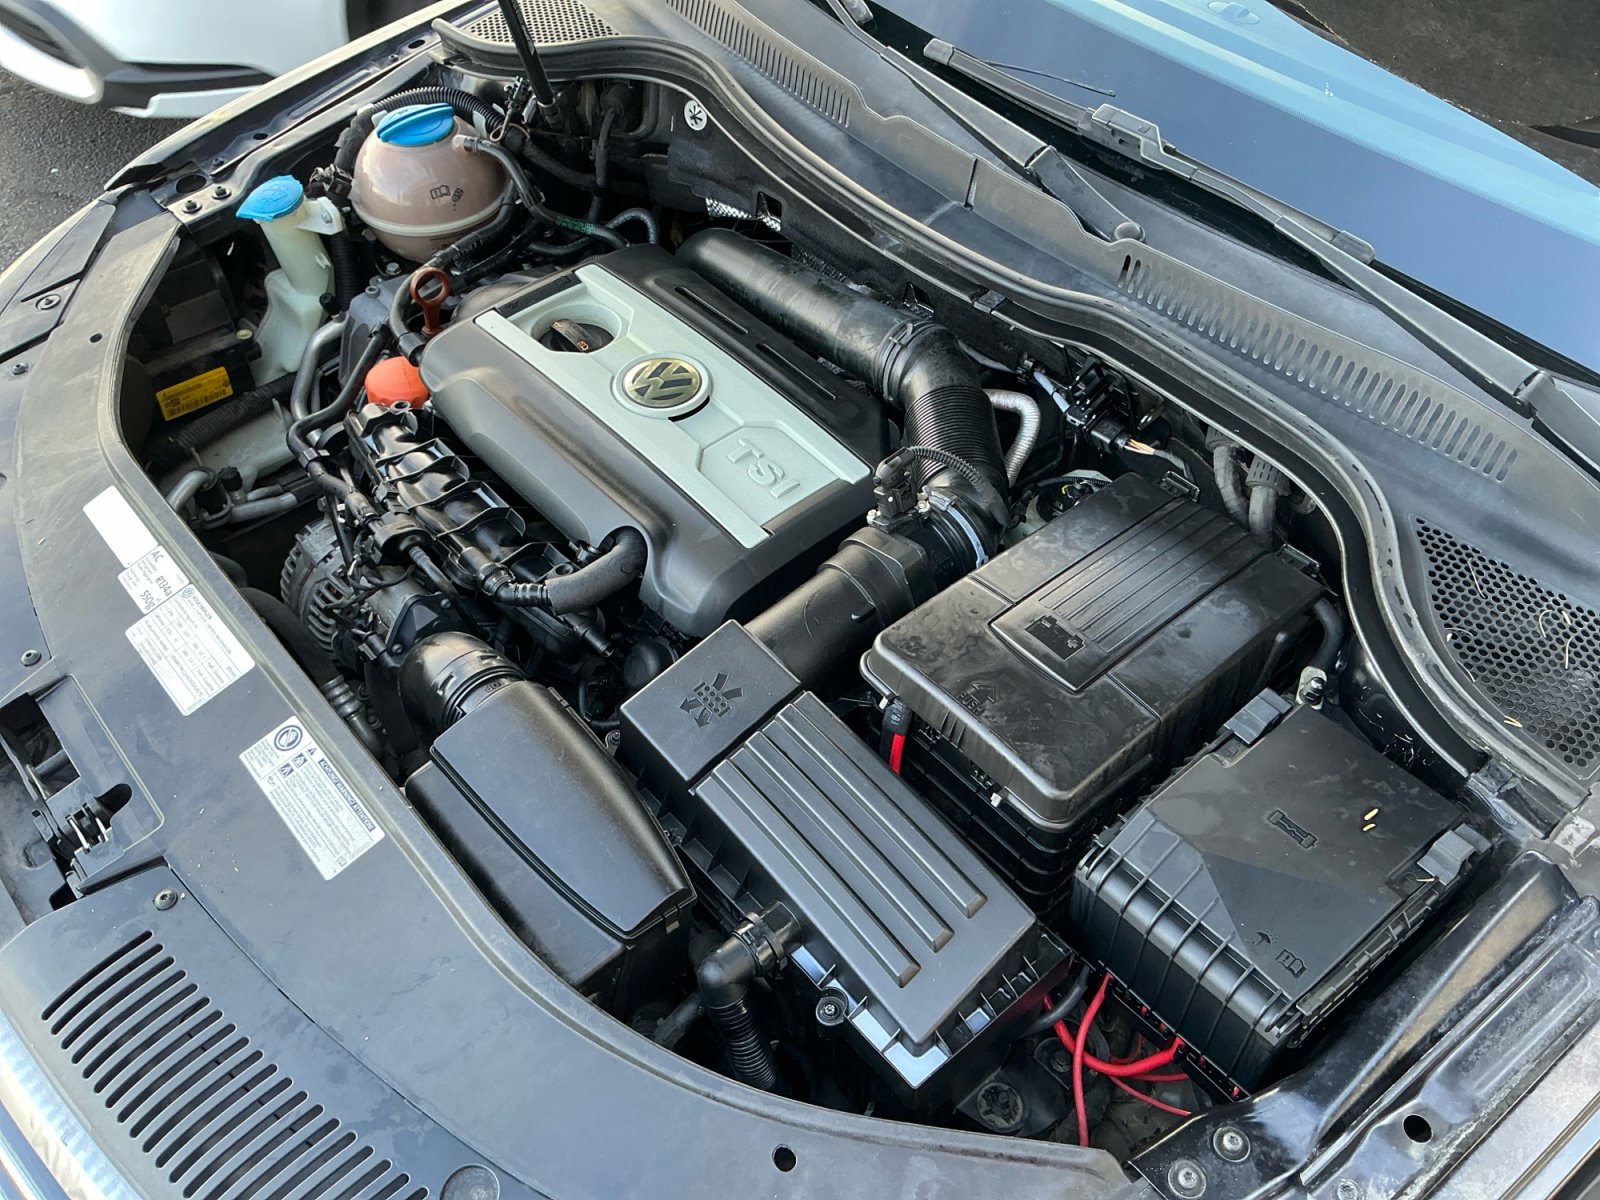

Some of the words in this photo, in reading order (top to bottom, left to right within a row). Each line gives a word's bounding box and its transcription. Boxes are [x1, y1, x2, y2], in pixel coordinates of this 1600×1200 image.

[726, 438, 801, 500] TSI
[150, 550, 164, 562] AC
[154, 575, 173, 596] R134a
[139, 589, 155, 610] 550g
[957, 692, 984, 715] PUSH
[319, 759, 339, 784] ACHTUNG!
[335, 781, 355, 805] WARNING!
[351, 803, 374, 831] ATTENTION!
